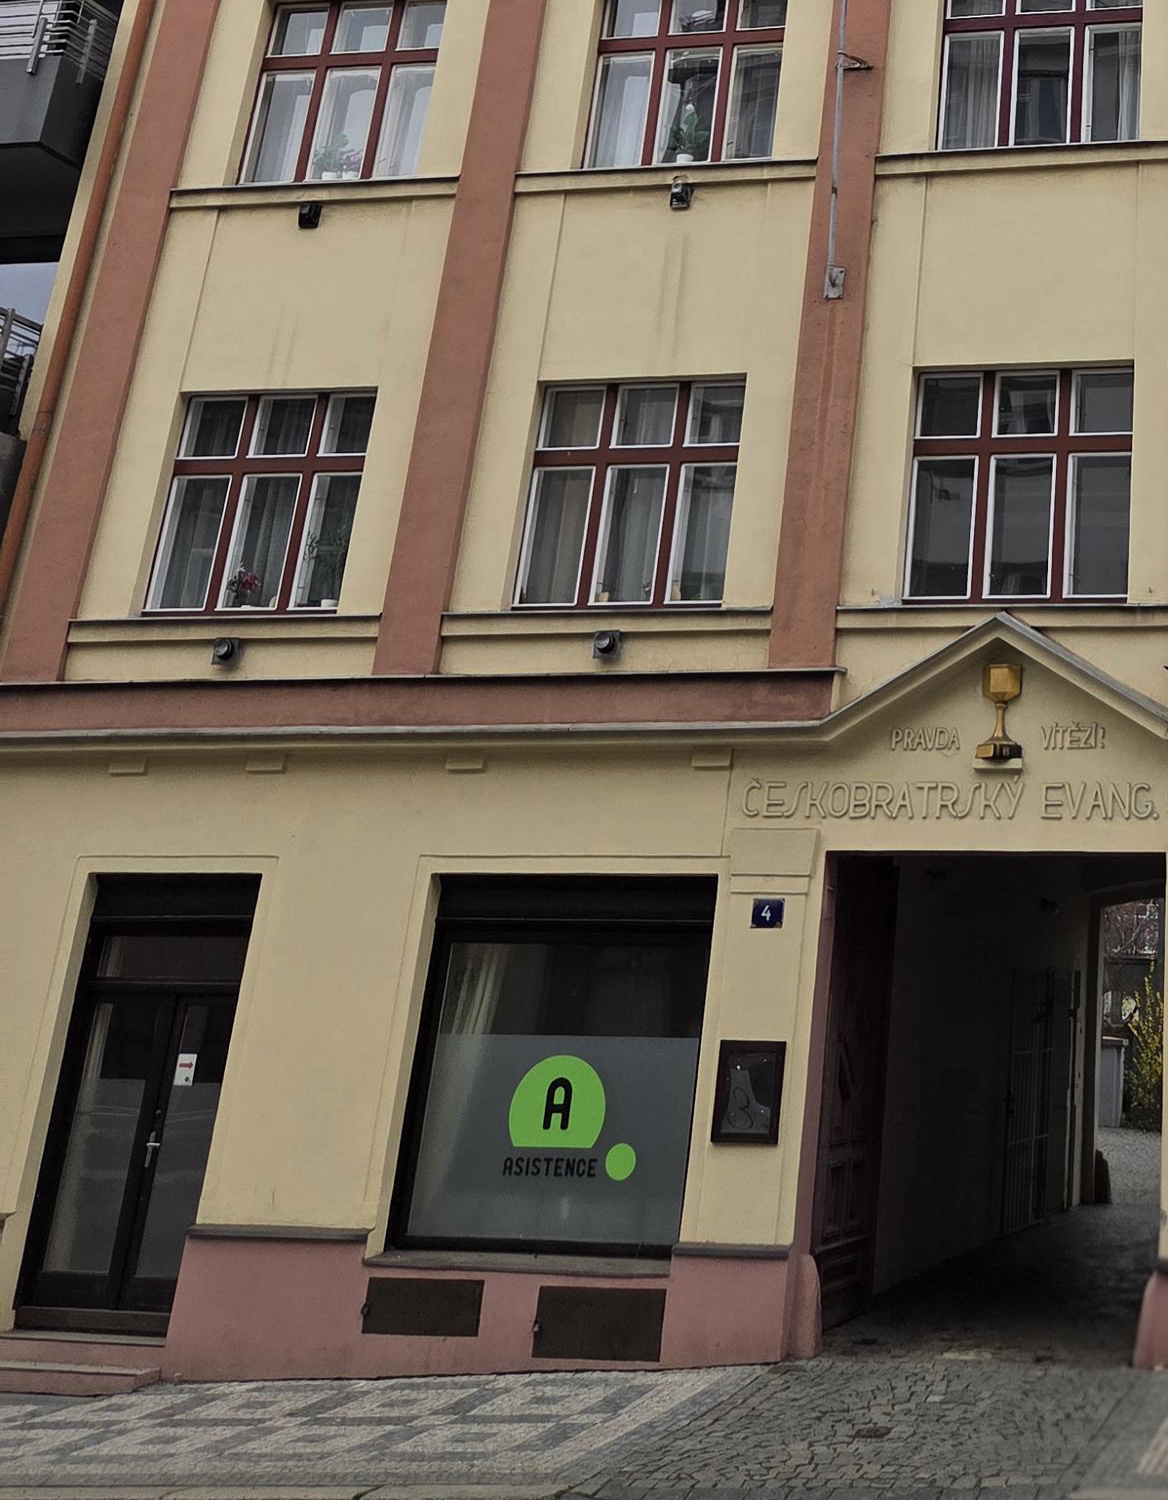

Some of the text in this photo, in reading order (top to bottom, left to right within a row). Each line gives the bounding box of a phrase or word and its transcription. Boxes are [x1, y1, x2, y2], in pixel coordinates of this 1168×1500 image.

[890, 727, 961, 751] PRAVDA
[742, 775, 1025, 821] ČESKOBRATRSKÝ
[1040, 781, 1160, 822] EVANG.
[760, 904, 772, 922] 4
[542, 1076, 573, 1131] A
[502, 1156, 598, 1179] ASISTENCE
